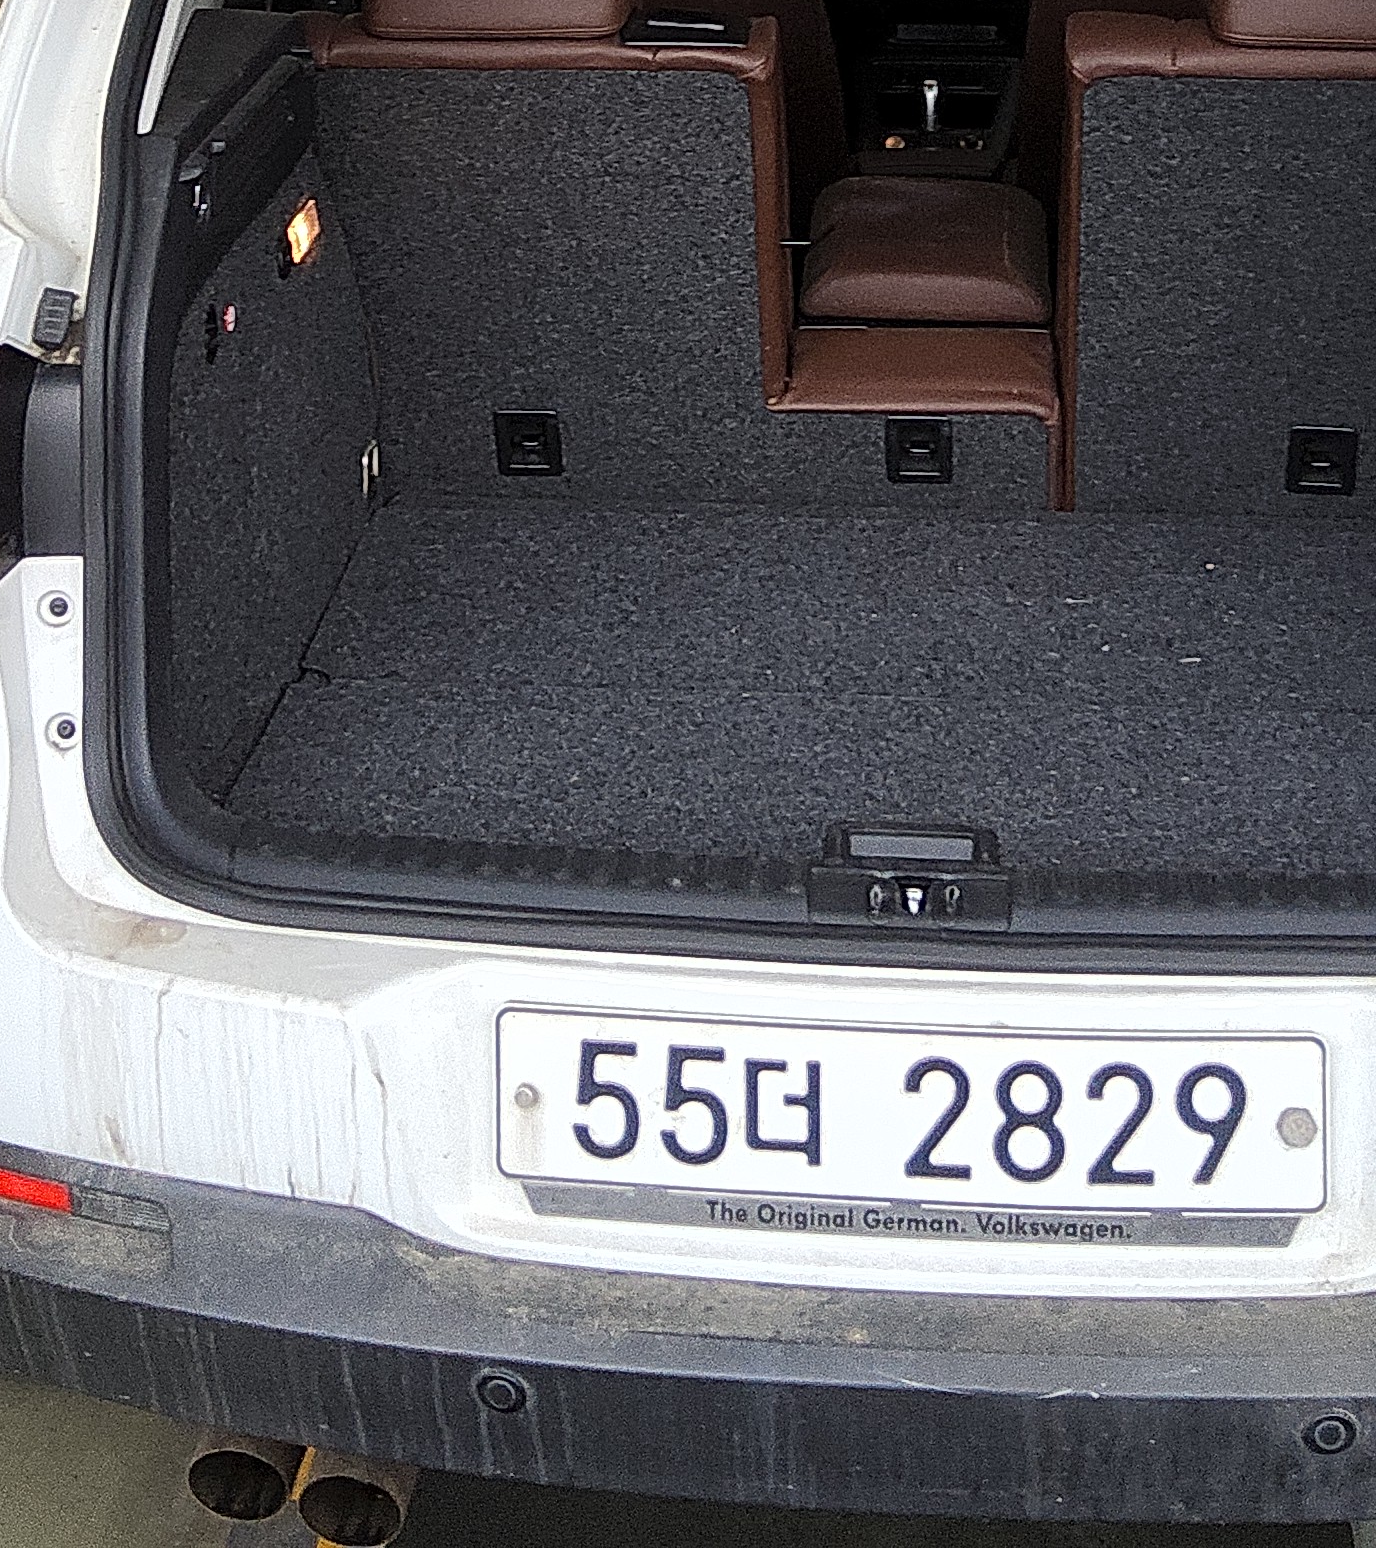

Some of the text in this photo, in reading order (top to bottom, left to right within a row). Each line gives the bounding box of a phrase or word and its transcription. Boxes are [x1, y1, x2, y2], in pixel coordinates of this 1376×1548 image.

[572, 1037, 1248, 1186] 55더 2829
[706, 1199, 1132, 1242] The Original German. Volkswagen.
